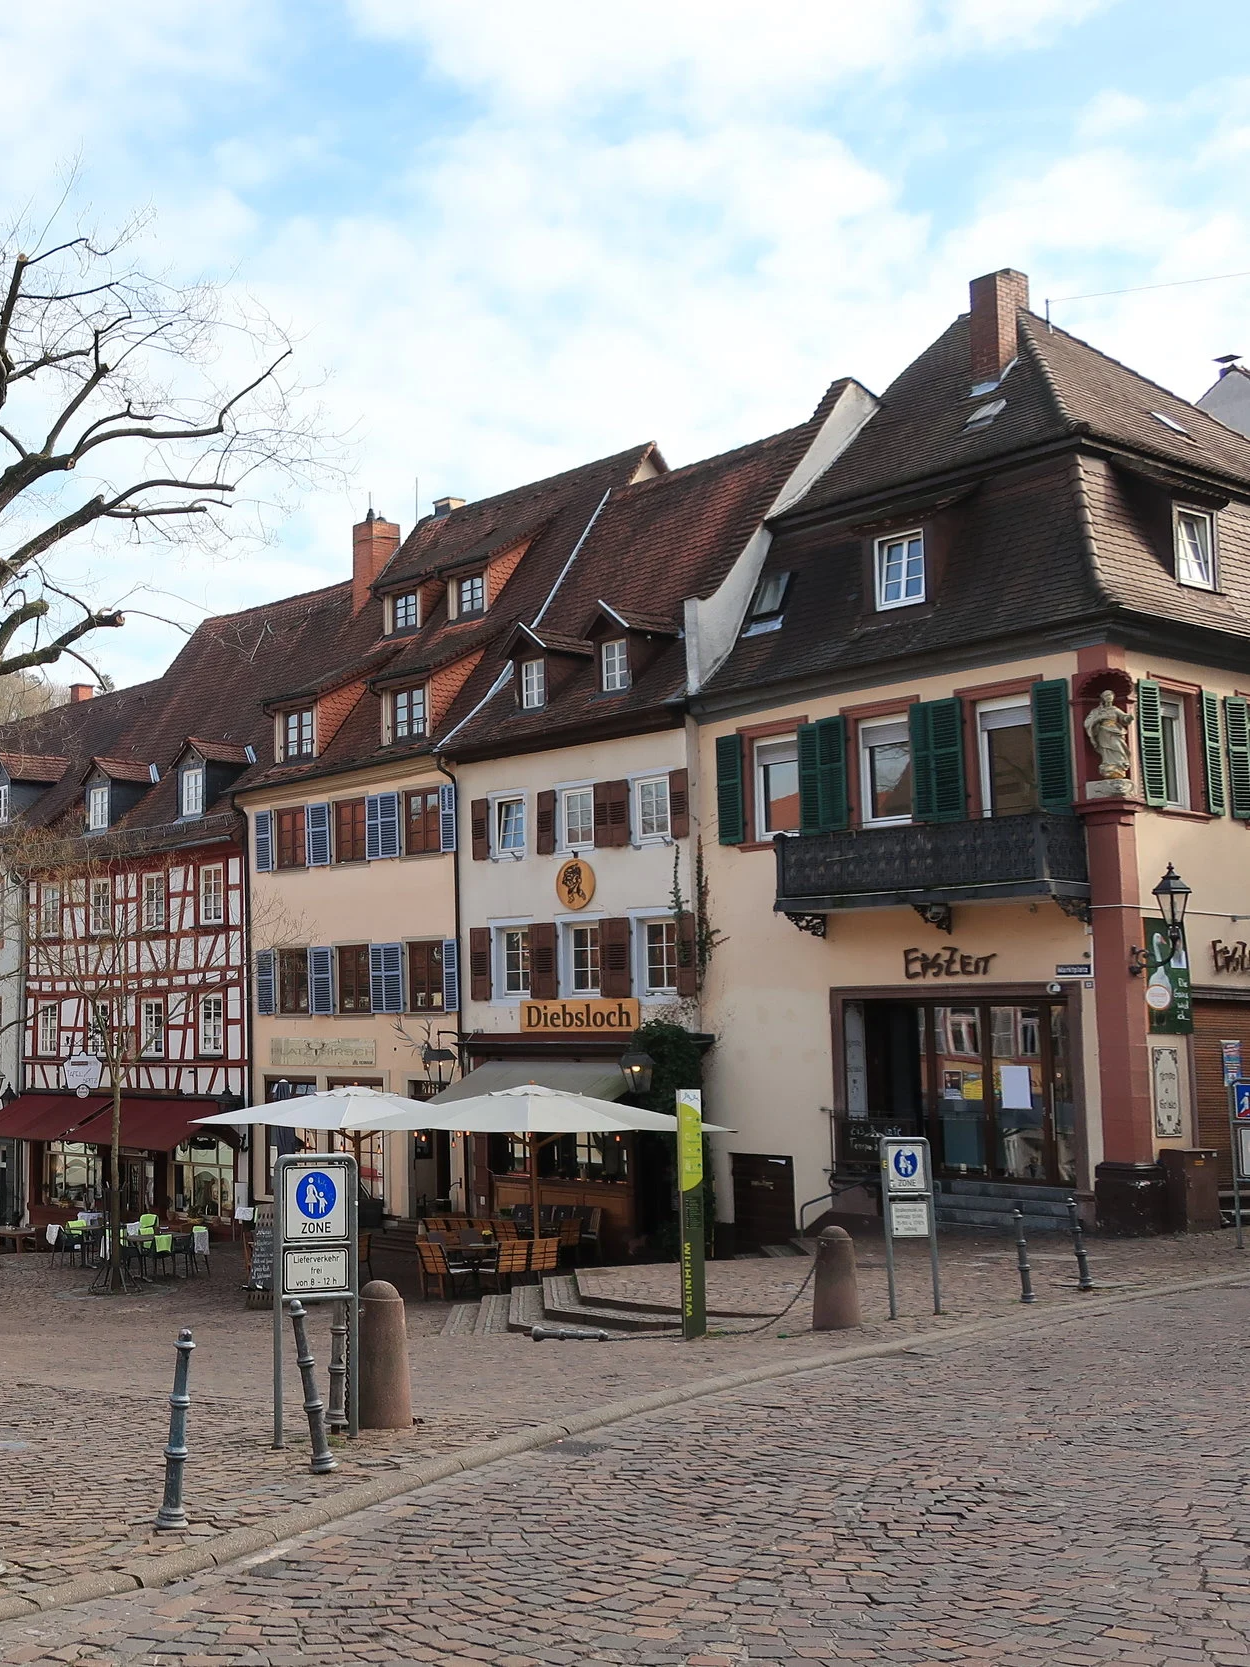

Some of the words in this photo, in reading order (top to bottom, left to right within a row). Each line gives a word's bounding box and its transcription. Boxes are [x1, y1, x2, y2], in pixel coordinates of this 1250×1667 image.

[526, 1003, 632, 1028] Diebsloch
[897, 1179, 917, 1187] ZONE
[301, 1222, 332, 1234] ZONE
[293, 1254, 340, 1264] Lieferverkehr
[310, 1266, 323, 1275] frei
[310, 1278, 315, 1286] 8
[323, 1277, 330, 1285] 12
[332, 1276, 338, 1285] h
[685, 1242, 693, 1317] WEINHEIM
